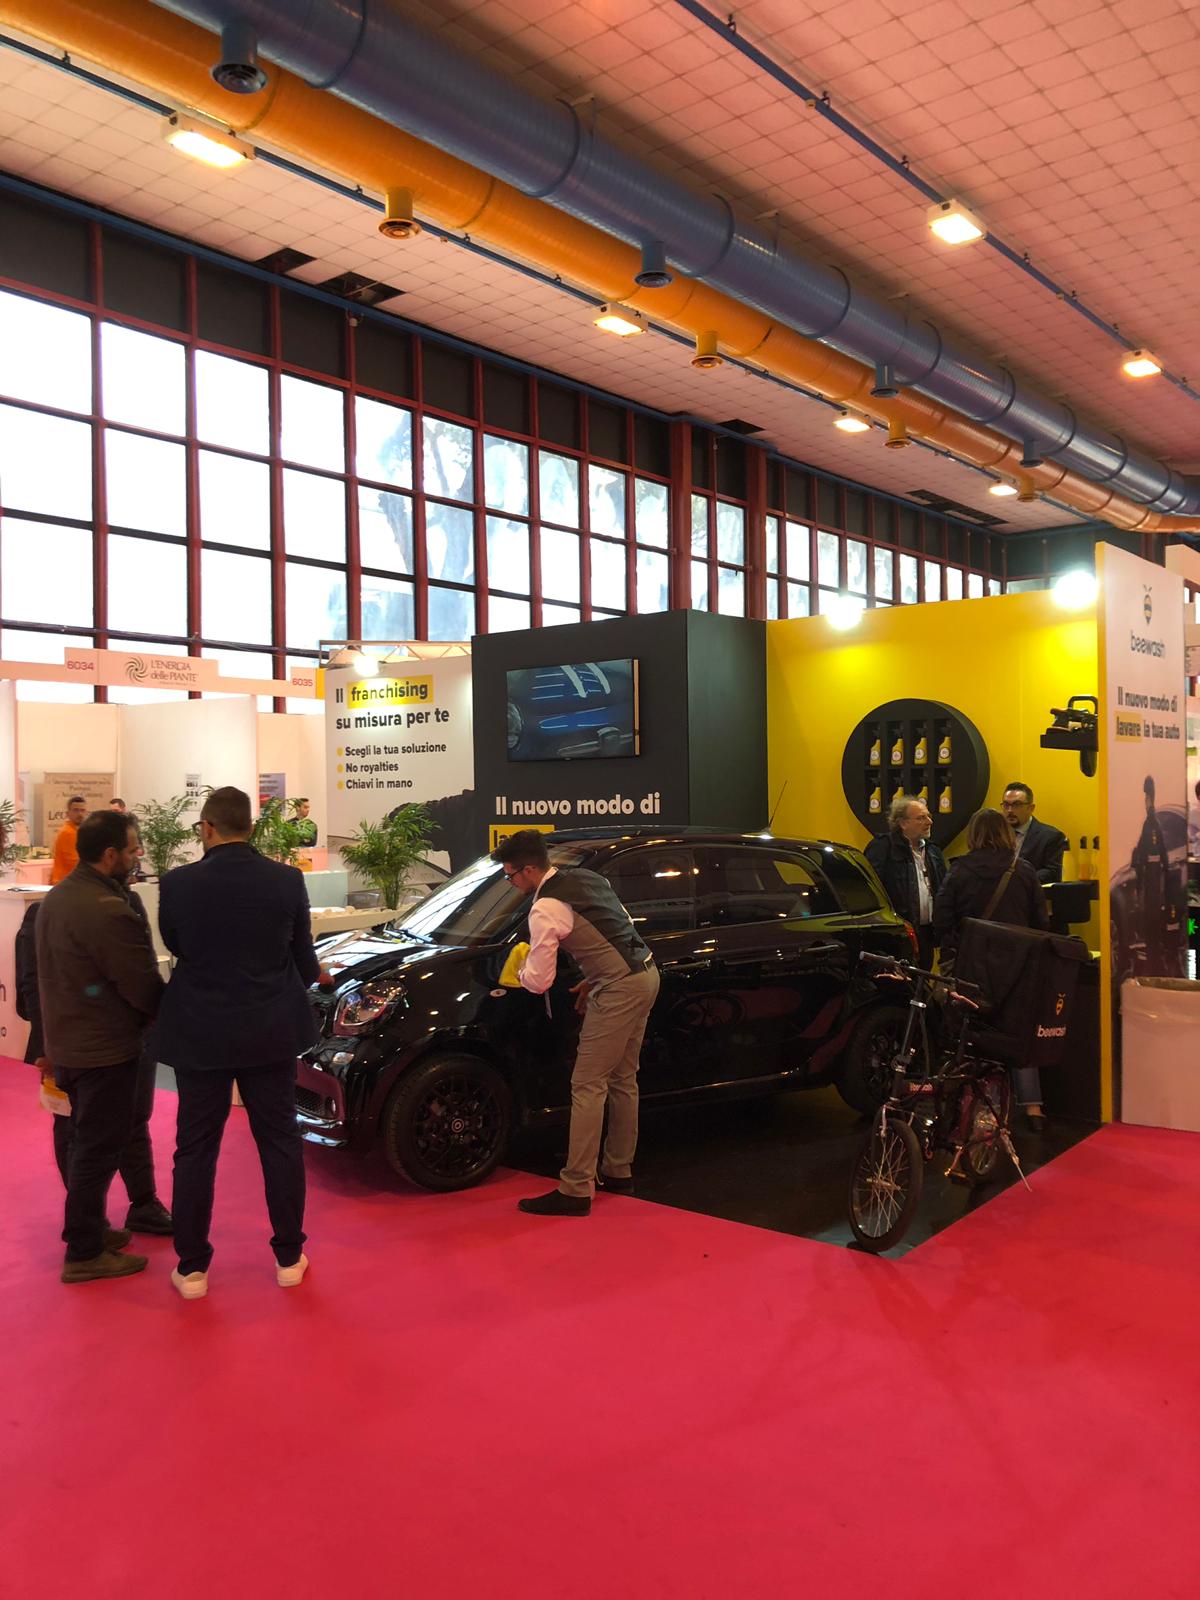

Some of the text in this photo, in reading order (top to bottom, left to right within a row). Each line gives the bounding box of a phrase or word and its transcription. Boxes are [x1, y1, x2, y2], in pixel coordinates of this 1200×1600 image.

[1130, 629, 1166, 659] beewash
[67, 661, 95, 671] 6034
[150, 659, 192, 671] L'ENERGIA
[150, 671, 198, 682] delle PIANTE
[292, 677, 313, 687] 6035
[336, 681, 428, 703] Il franchising
[1117, 686, 1178, 712] Il nuovo modo di
[336, 708, 449, 730] su misura per te
[1116, 716, 1180, 740] lavare la tua auto
[345, 742, 447, 758] Scegli la tua soluzione
[345, 761, 399, 774] No royalties
[346, 778, 413, 789] Chiavi in mano
[495, 792, 661, 816] Il nuovo modo di
